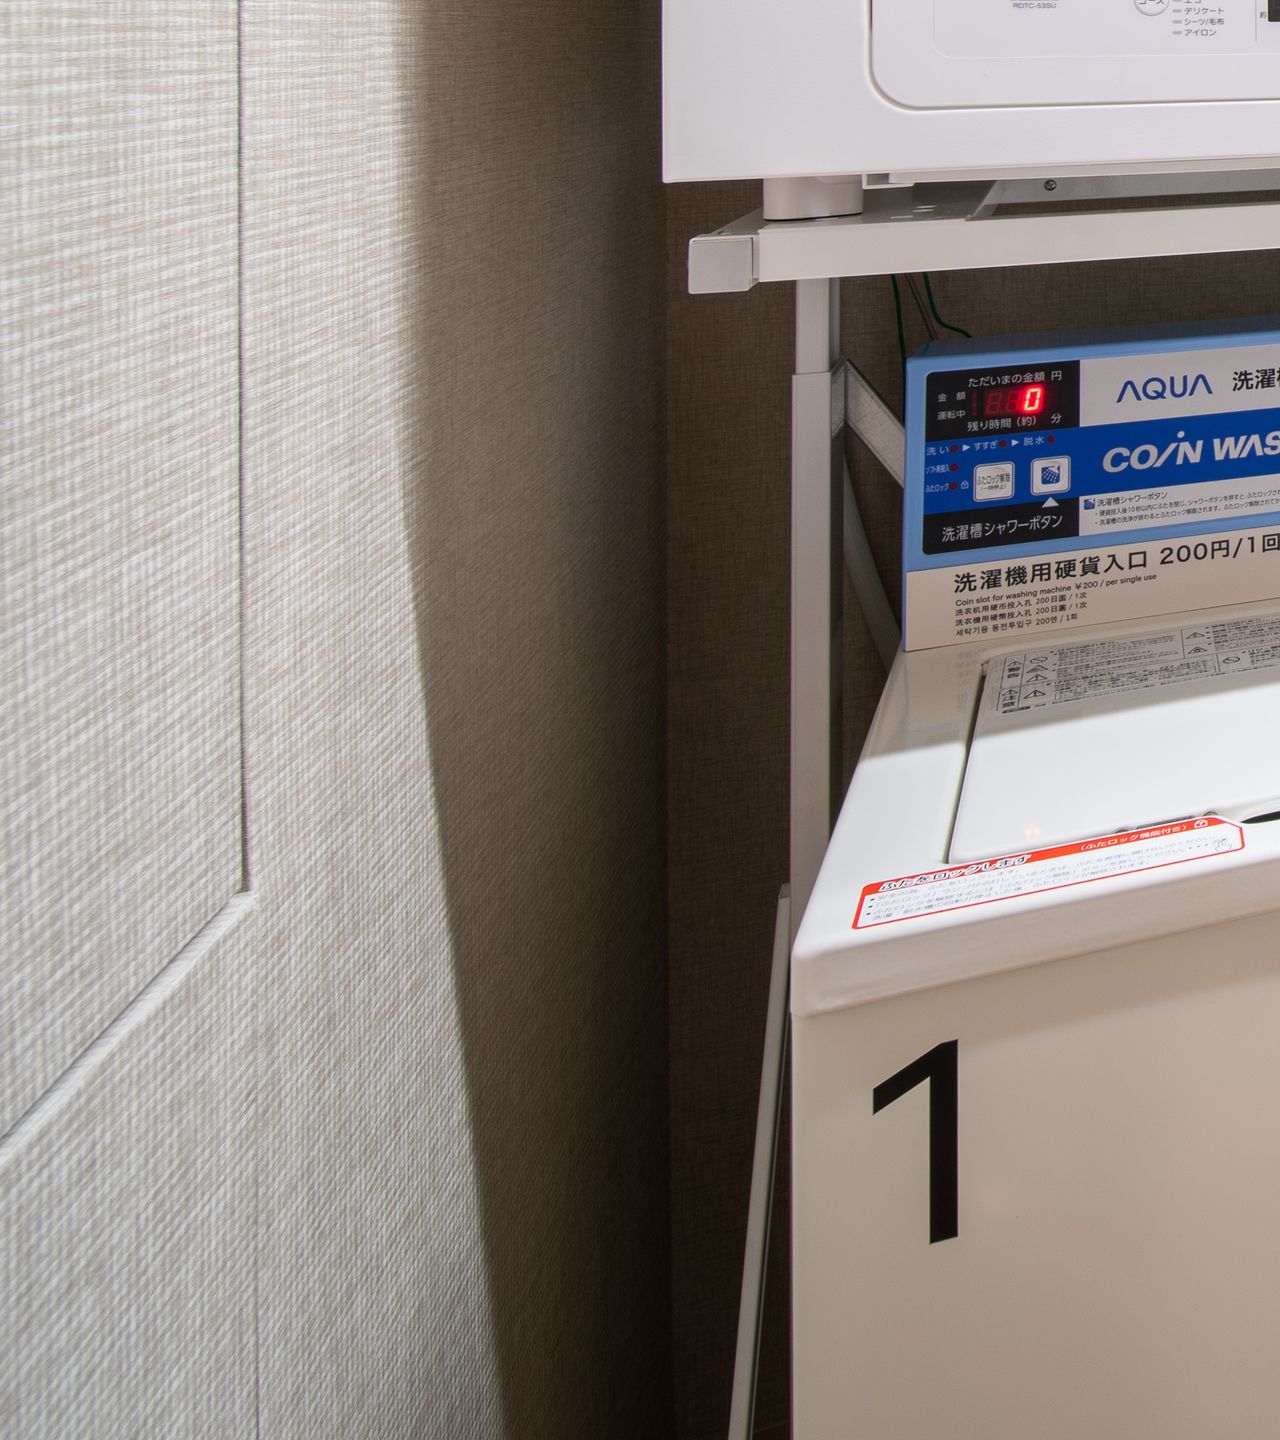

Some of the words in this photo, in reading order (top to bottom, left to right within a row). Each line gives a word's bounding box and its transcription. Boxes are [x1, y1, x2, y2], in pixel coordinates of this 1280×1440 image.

[968, 372, 1045, 387] ただいまの金額
[1051, 371, 1062, 381] 円
[1116, 374, 1213, 403] AQUA
[1024, 387, 1042, 411] 0
[937, 410, 965, 421] 運転中
[1051, 413, 1061, 424] 分
[974, 440, 998, 450] すすぎ
[1024, 437, 1044, 446] 脱水
[1103, 431, 1203, 473] COIN
[977, 473, 1010, 485] ふたロック解除
[1097, 491, 1167, 508] 洗濯槽シャワーボタン
[942, 515, 1062, 542] 洗濯槽シャワーボタン
[954, 550, 1148, 594] 洗濯機用硬貨入口
[1160, 532, 1280, 566] 200円/1回
[956, 598, 973, 607] Coin
[976, 596, 990, 604] slot
[992, 594, 1003, 602] for
[1006, 590, 1037, 601] washing
[1040, 585, 1072, 596] machine
[1106, 578, 1118, 588] per
[1120, 575, 1142, 586] single
[1144, 573, 1156, 581] use
[879, 853, 1032, 892] ふたをロックします
[873, 1039, 958, 1244] 1
